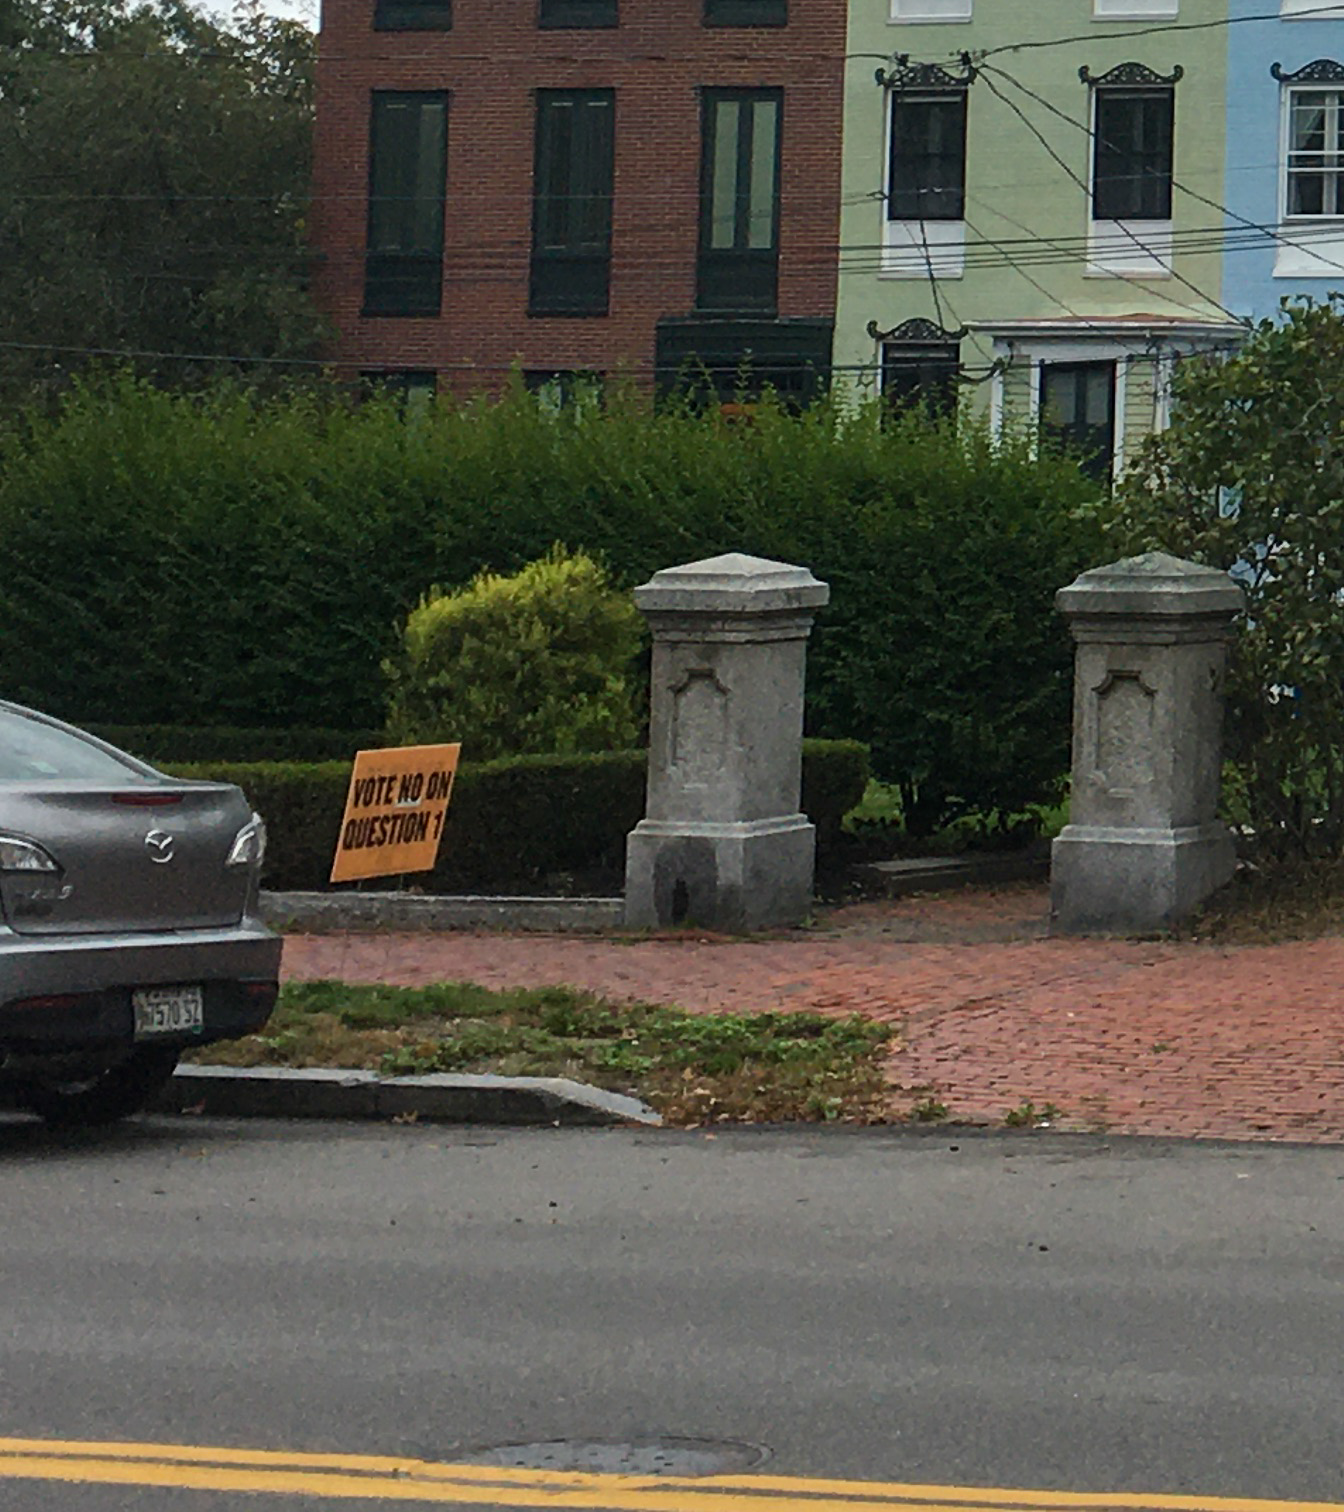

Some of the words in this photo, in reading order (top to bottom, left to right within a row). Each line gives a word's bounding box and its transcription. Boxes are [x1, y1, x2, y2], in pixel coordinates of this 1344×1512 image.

[353, 774, 397, 808] VOTE
[398, 772, 424, 804] NO
[426, 770, 452, 800] ON
[342, 810, 431, 850] QUESTION
[433, 810, 443, 840] 1
